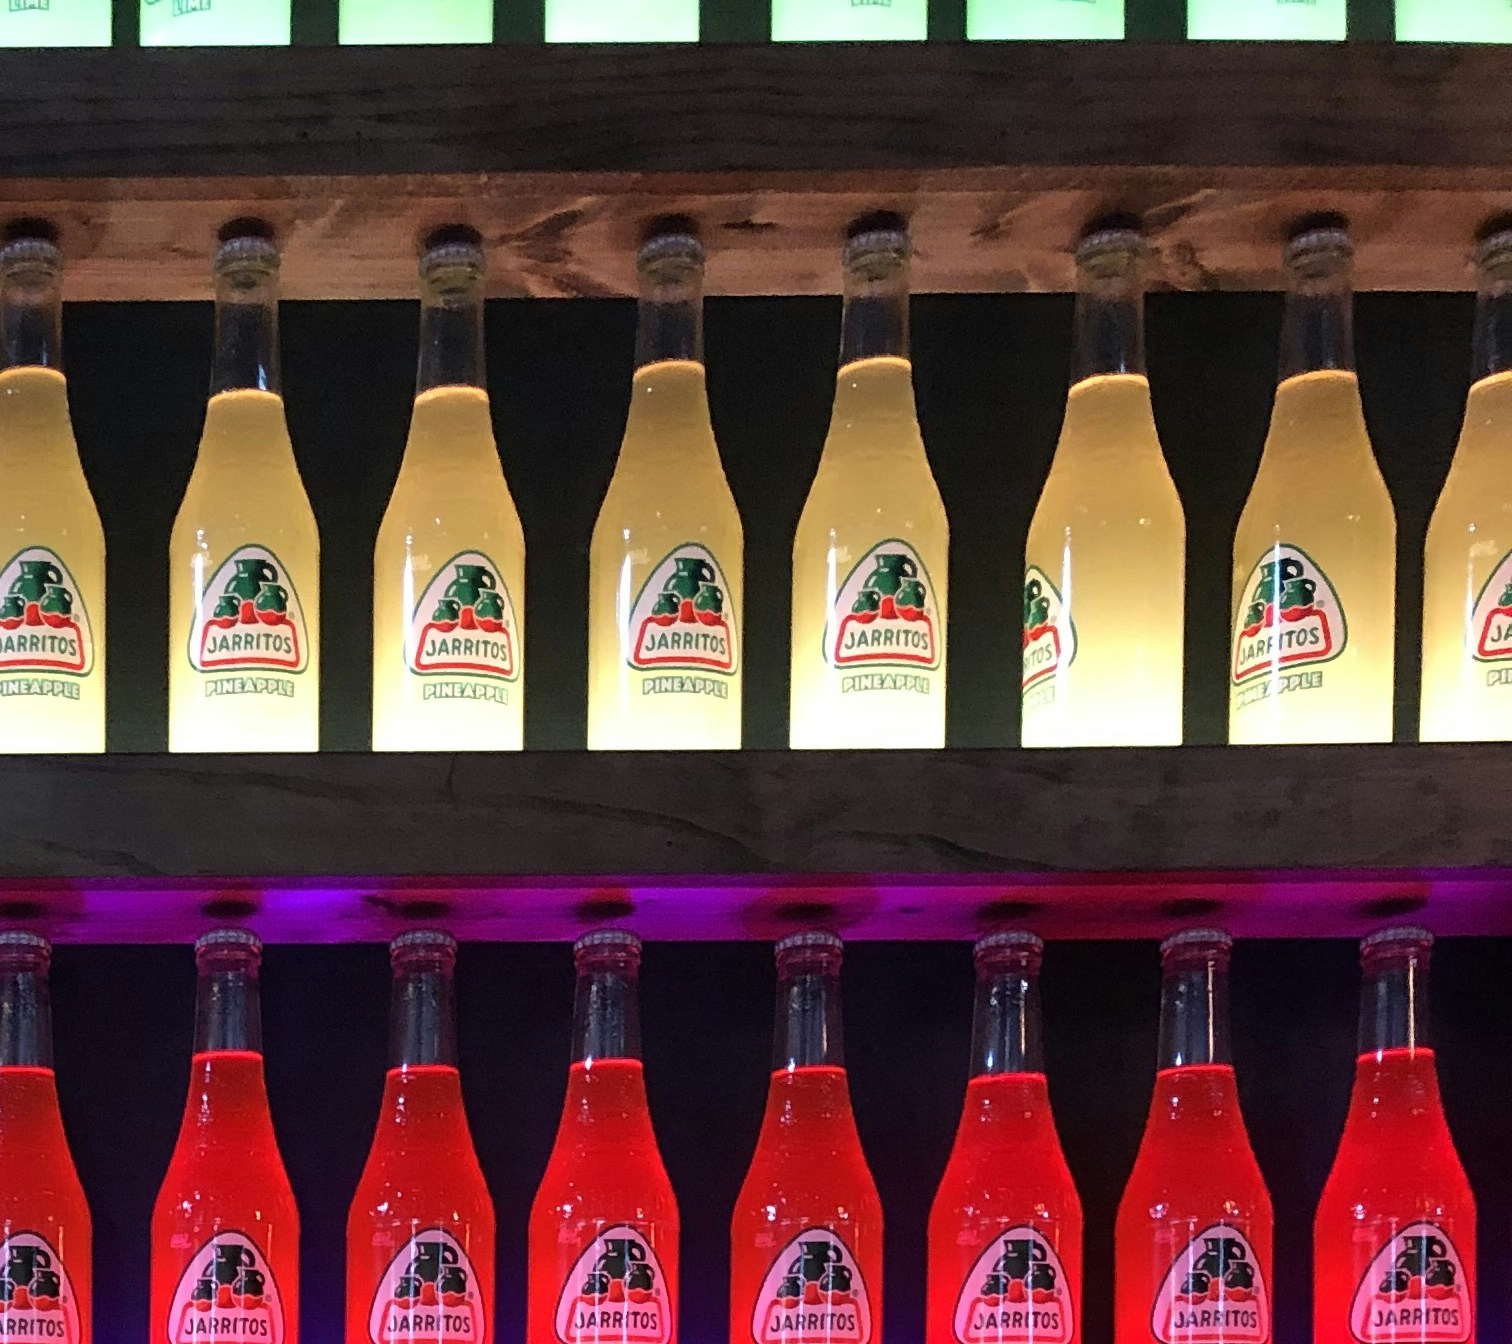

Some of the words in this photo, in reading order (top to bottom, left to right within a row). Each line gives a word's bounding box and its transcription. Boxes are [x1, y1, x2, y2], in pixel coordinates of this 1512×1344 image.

[206, 632, 292, 655] JARRITOS
[425, 635, 507, 662] JARRITOS
[644, 632, 726, 656] JARRITOS
[844, 632, 929, 653] JARRITOS
[205, 677, 294, 698] PINEAPPLE
[423, 683, 508, 706] PINEAPPLE
[642, 677, 728, 699] PINEAPPLE
[842, 674, 930, 694] PINEAPPLE
[184, 1317, 268, 1337] JARRITOS
[388, 1314, 471, 1334] JARRITOS
[574, 1310, 658, 1331] JARRITOS
[770, 1313, 855, 1333] JARRITOS
[974, 1311, 1059, 1331] JARRITOS
[1174, 1310, 1258, 1330] JARRITOS
[1372, 1307, 1459, 1328] JARRITOS
